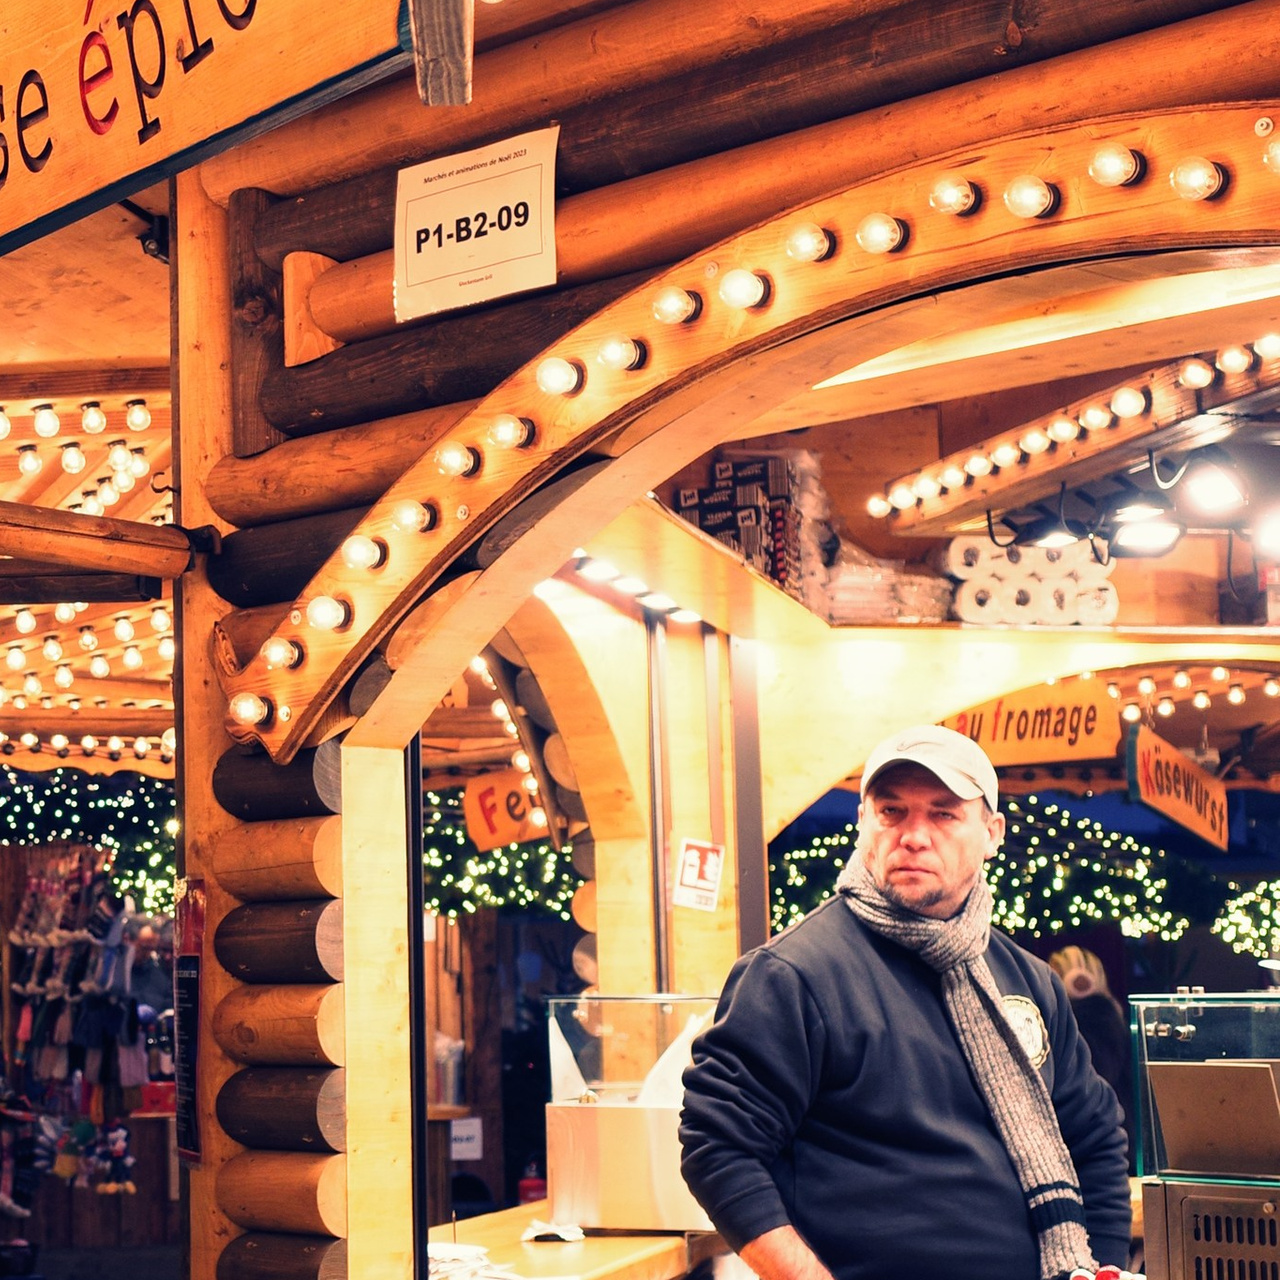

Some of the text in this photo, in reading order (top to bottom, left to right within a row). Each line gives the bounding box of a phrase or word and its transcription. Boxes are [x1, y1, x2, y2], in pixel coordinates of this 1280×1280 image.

[455, 162, 488, 175] animations
[513, 148, 527, 159] 2023
[416, 202, 529, 254] P1-B2-09
[956, 698, 1097, 746] au fromage
[1142, 745, 1225, 841] Käsewurst
